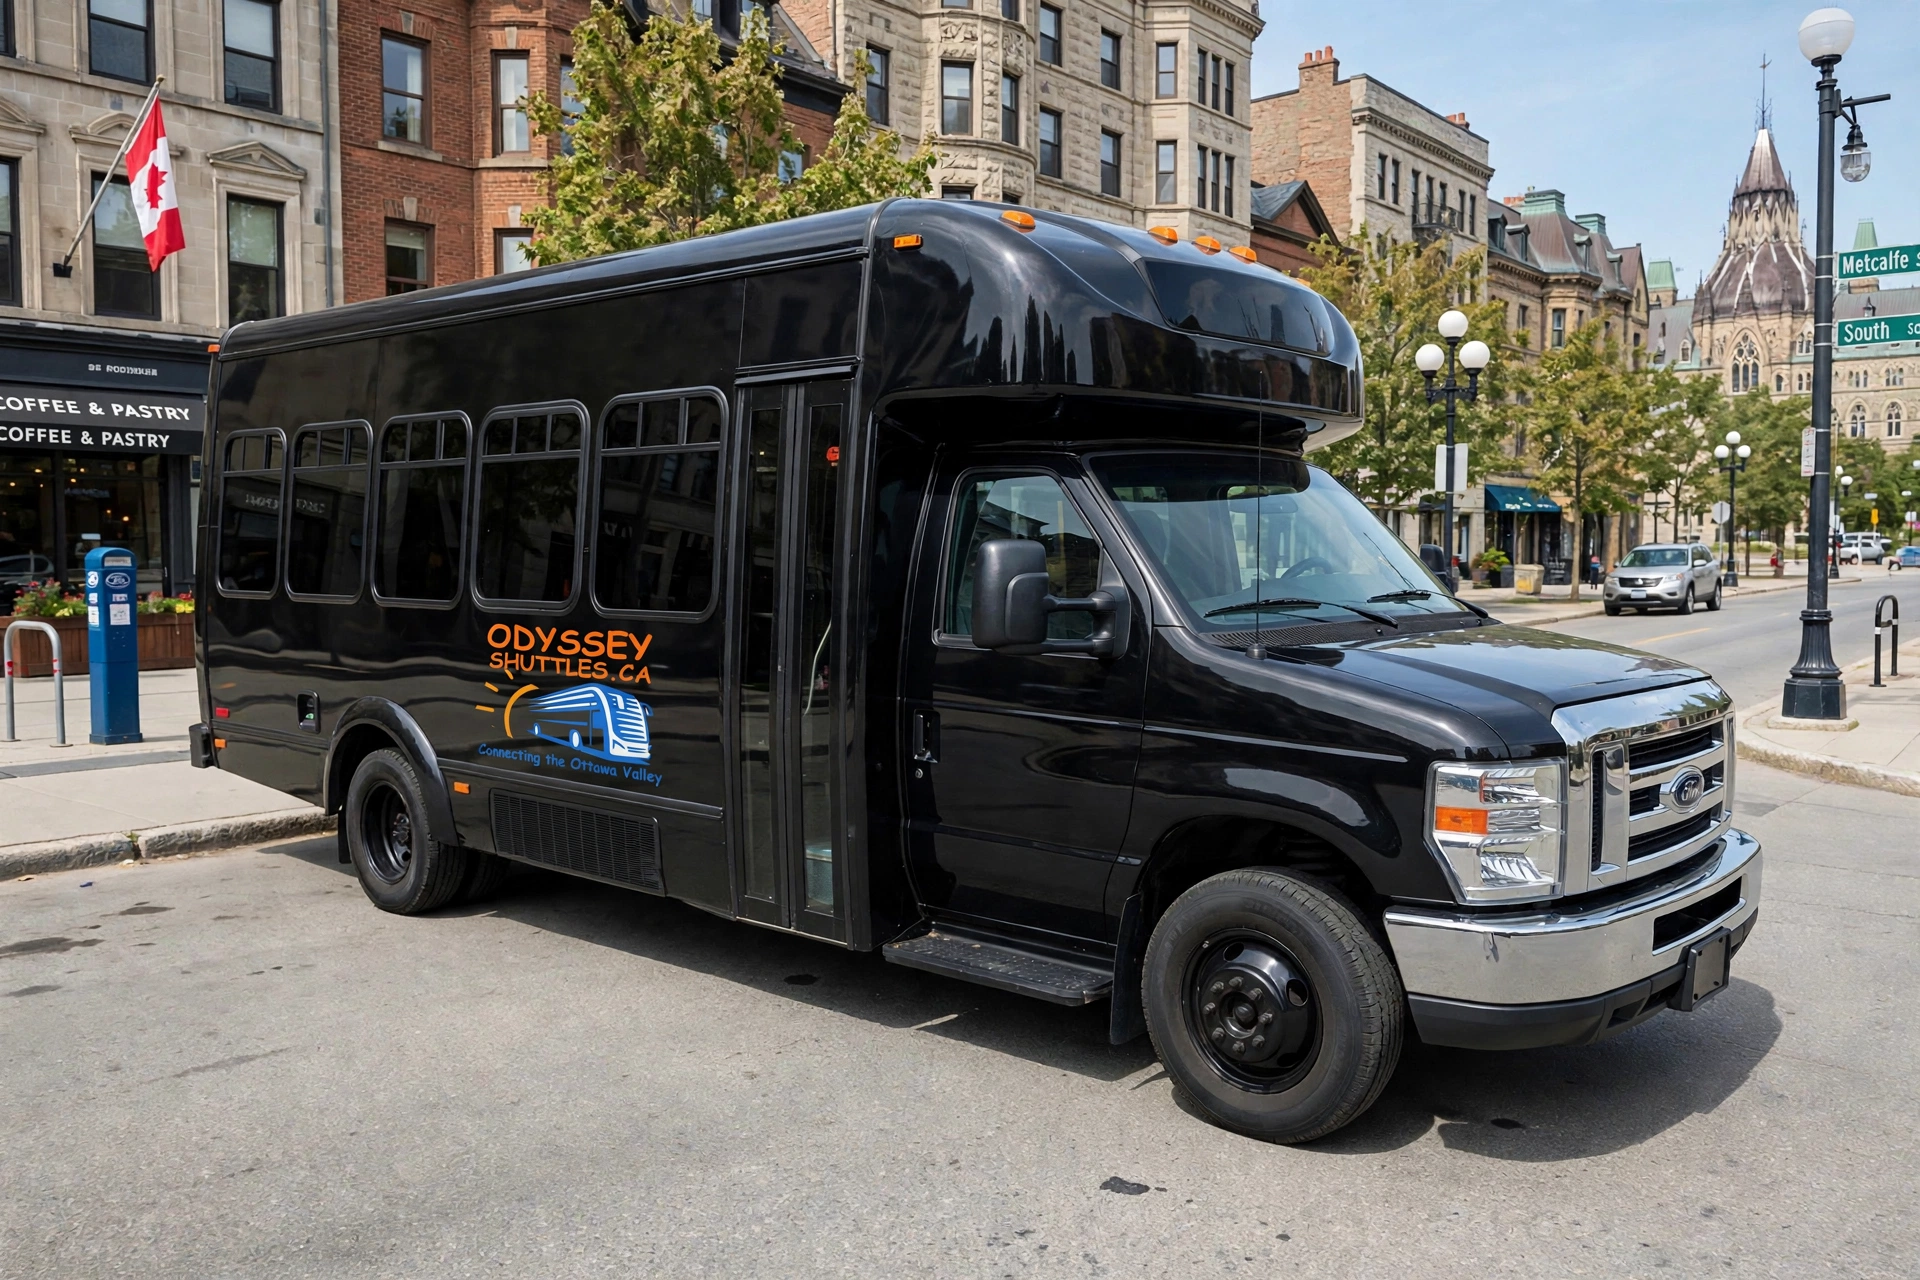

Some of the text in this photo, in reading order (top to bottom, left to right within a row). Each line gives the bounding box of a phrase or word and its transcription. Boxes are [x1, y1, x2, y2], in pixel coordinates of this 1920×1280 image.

[1842, 250, 1909, 275] Metcalfe
[1844, 322, 1890, 343] South
[88, 402, 105, 415] &
[111, 403, 190, 420] PASTRY
[0, 426, 170, 448] COFFEE & PASTRY
[487, 623, 653, 661] ODYSSEY
[489, 652, 652, 685] SHUTTLES.CA
[478, 743, 663, 787] Connecting the Ottawa Valley
